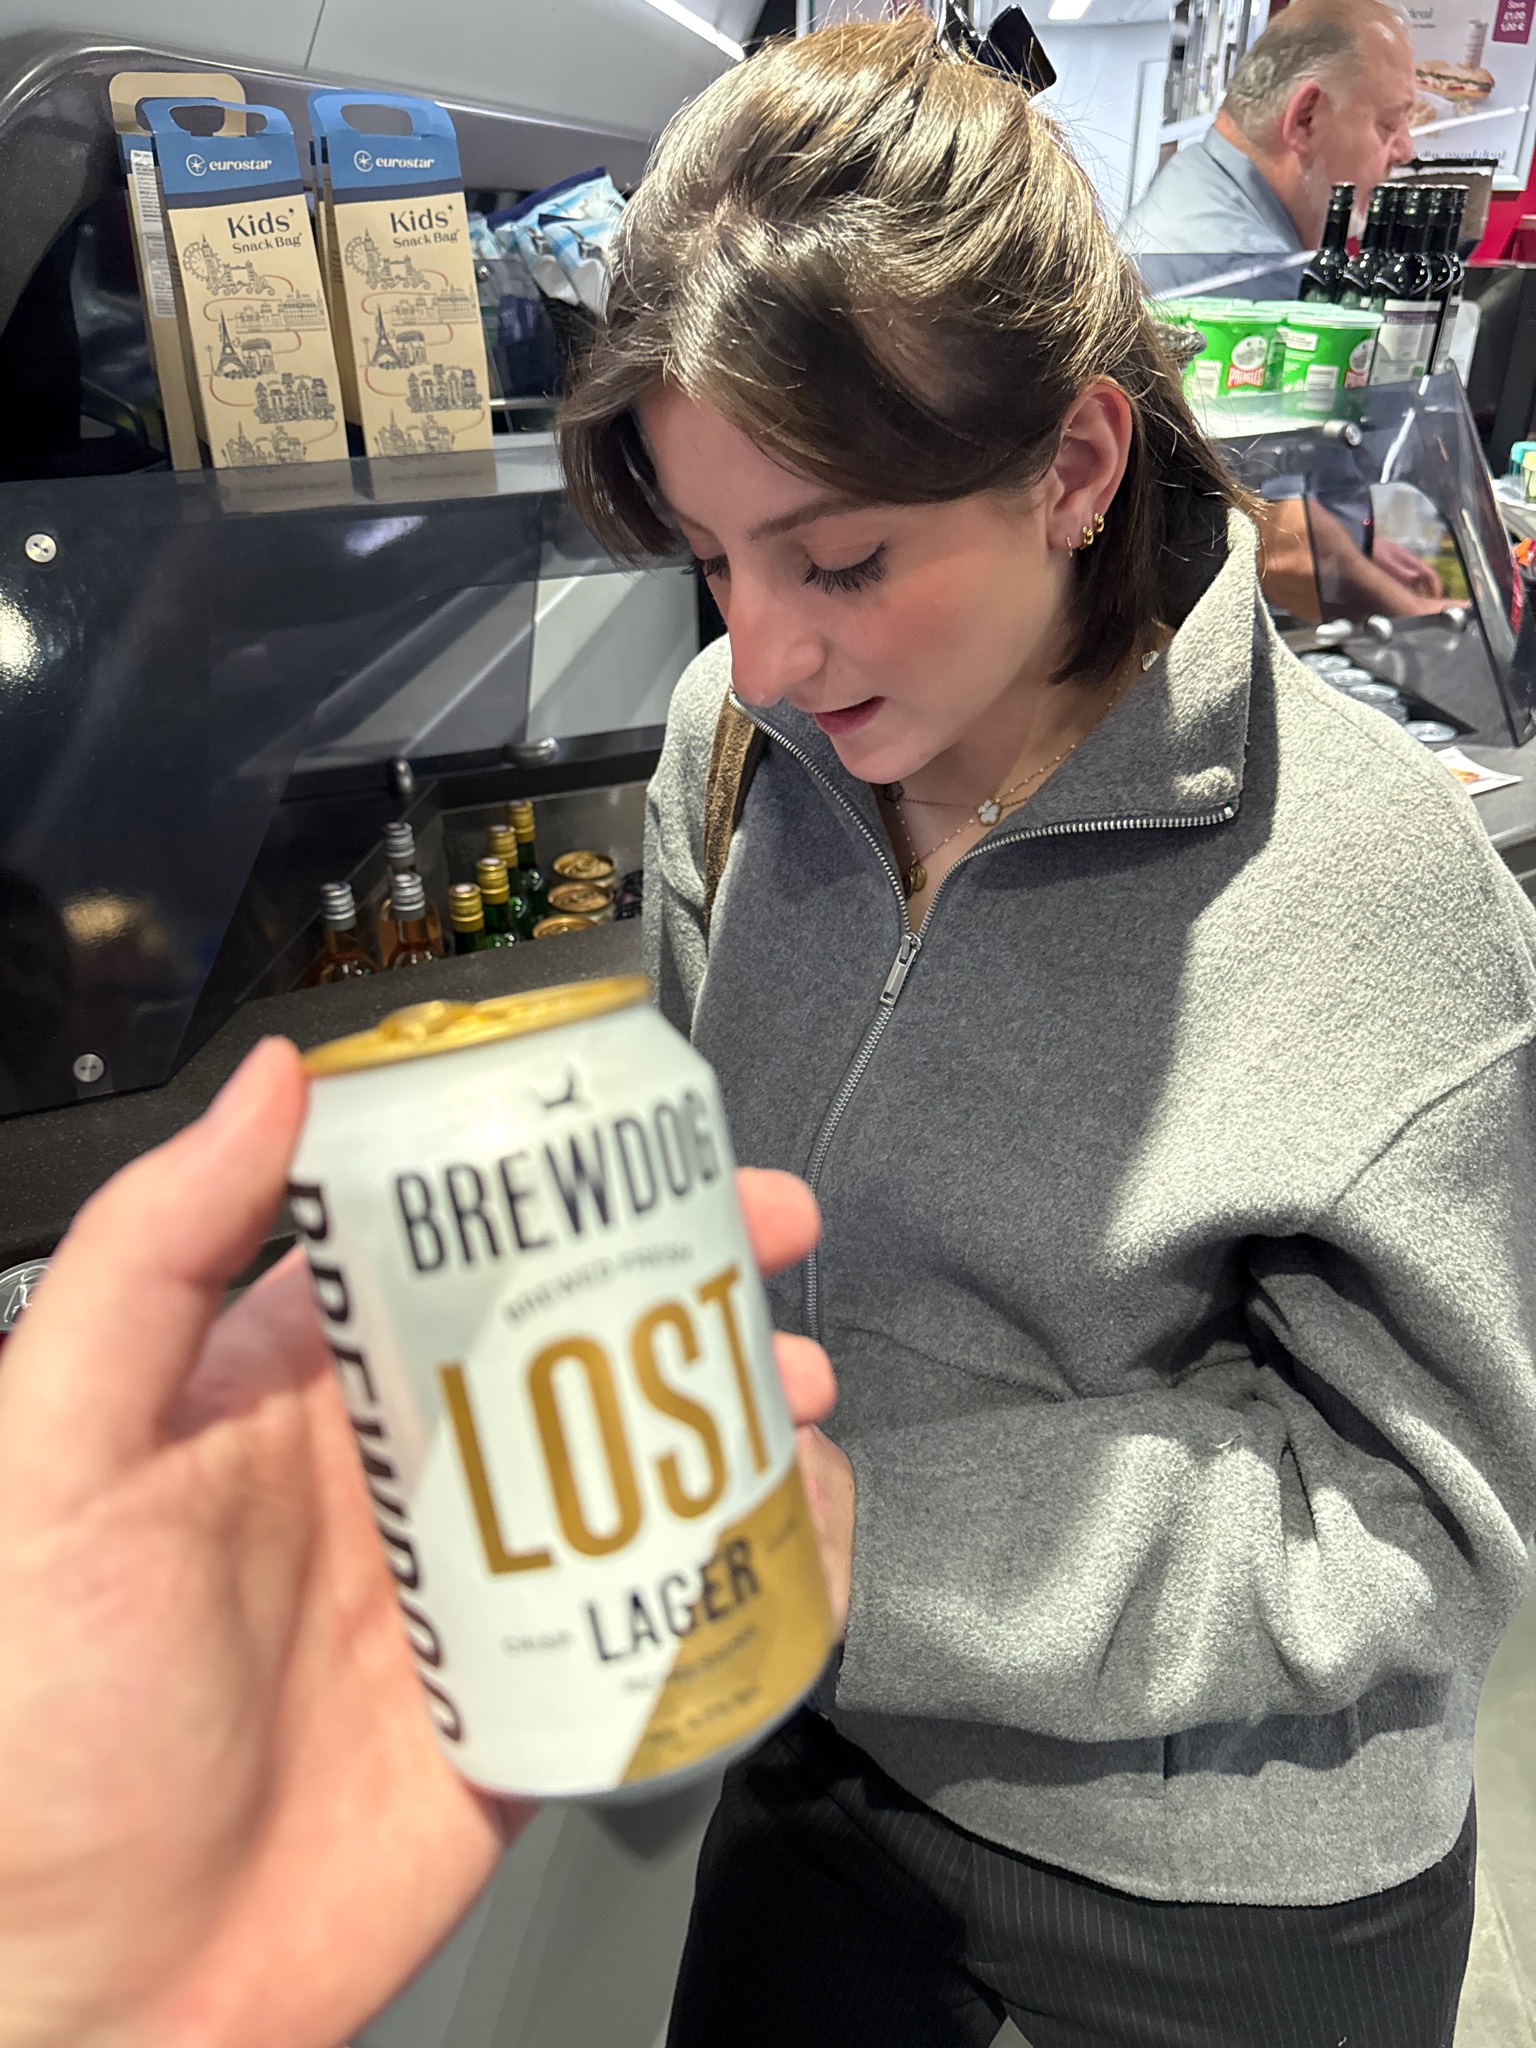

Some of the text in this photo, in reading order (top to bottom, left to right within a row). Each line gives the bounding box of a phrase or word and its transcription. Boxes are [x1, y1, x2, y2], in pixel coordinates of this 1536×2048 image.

[208, 159, 273, 171] eurostar
[376, 157, 435, 169] eurostar
[232, 239, 274, 254] Snack
[393, 234, 432, 249] Snack
[395, 1091, 718, 1272] BREWDOG
[439, 1264, 769, 1575] LOST
[587, 1535, 761, 1662] LAGER
